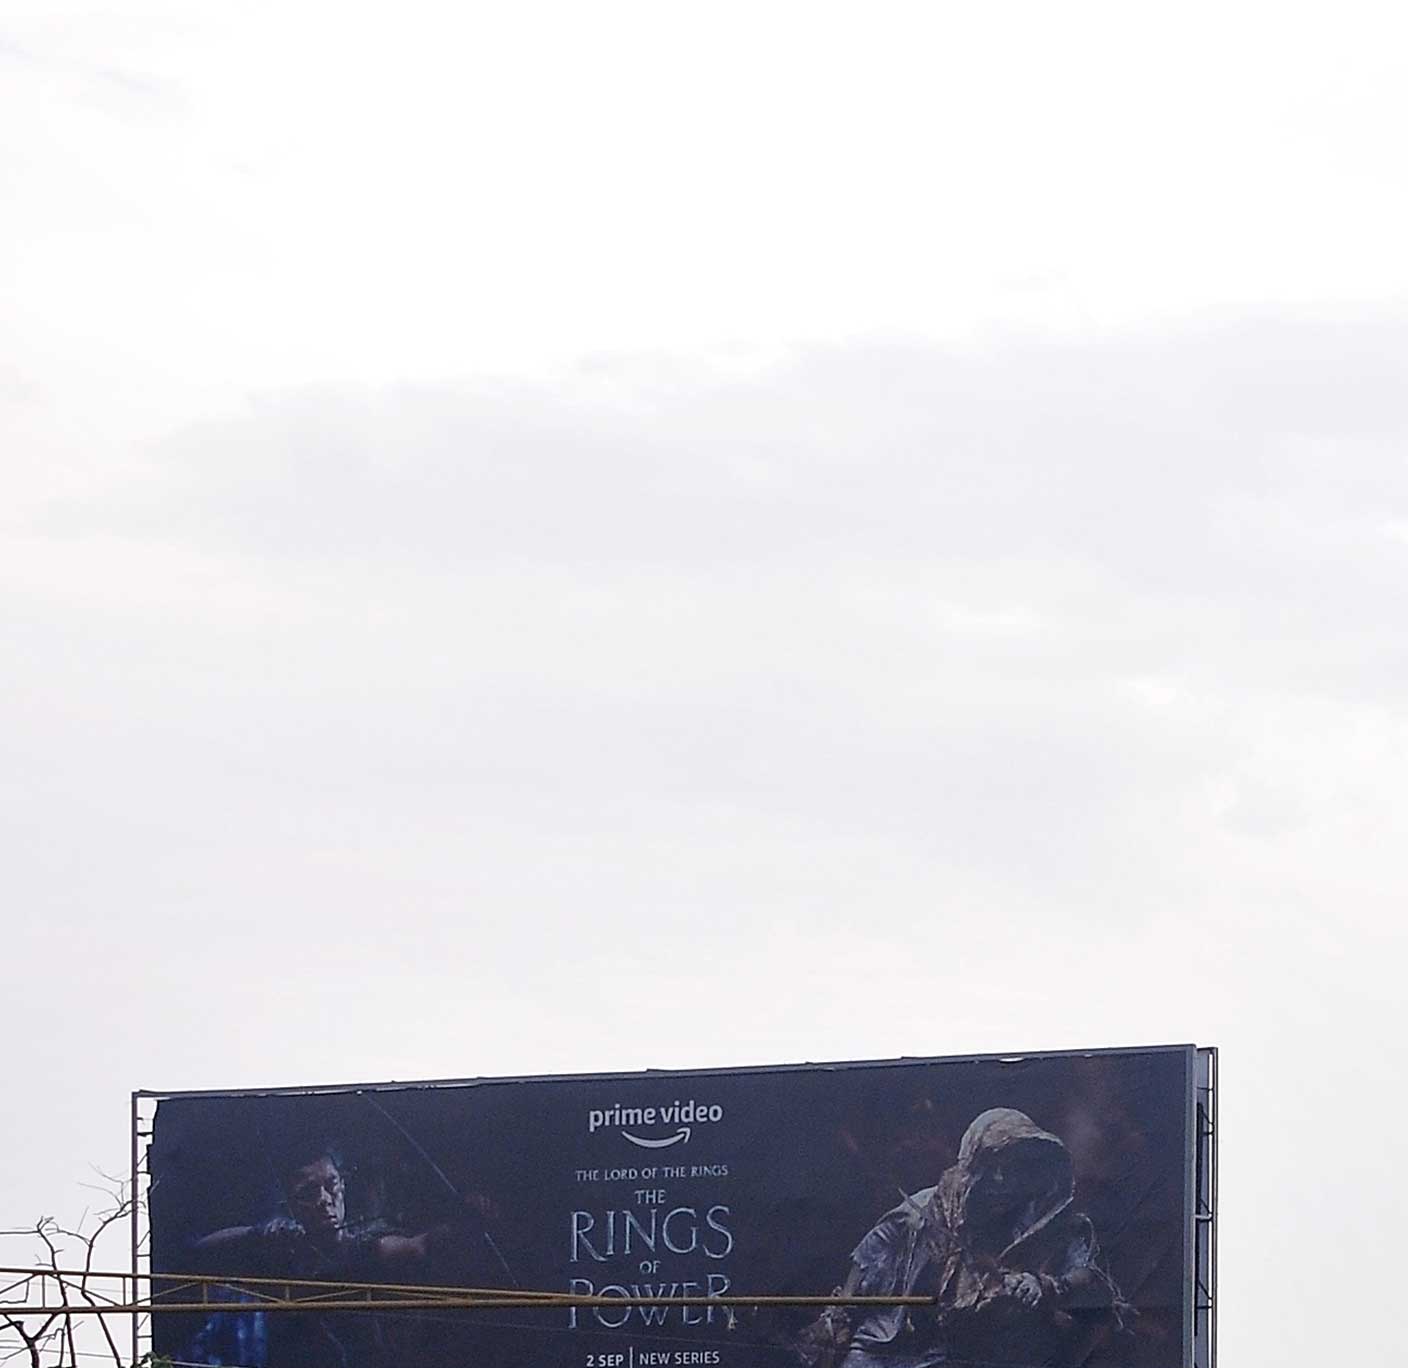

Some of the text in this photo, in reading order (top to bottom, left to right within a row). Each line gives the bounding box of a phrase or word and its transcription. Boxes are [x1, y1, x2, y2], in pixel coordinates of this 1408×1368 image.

[588, 1100, 723, 1132] prime video
[575, 1165, 728, 1181] THE LORD OF THE RINGS
[634, 1189, 667, 1204] THE
[569, 1205, 733, 1262] RINGS
[639, 1260, 662, 1274] OF
[567, 1273, 736, 1329] POWER
[585, 1350, 721, 1367] 2 SEP NEW SERIES
